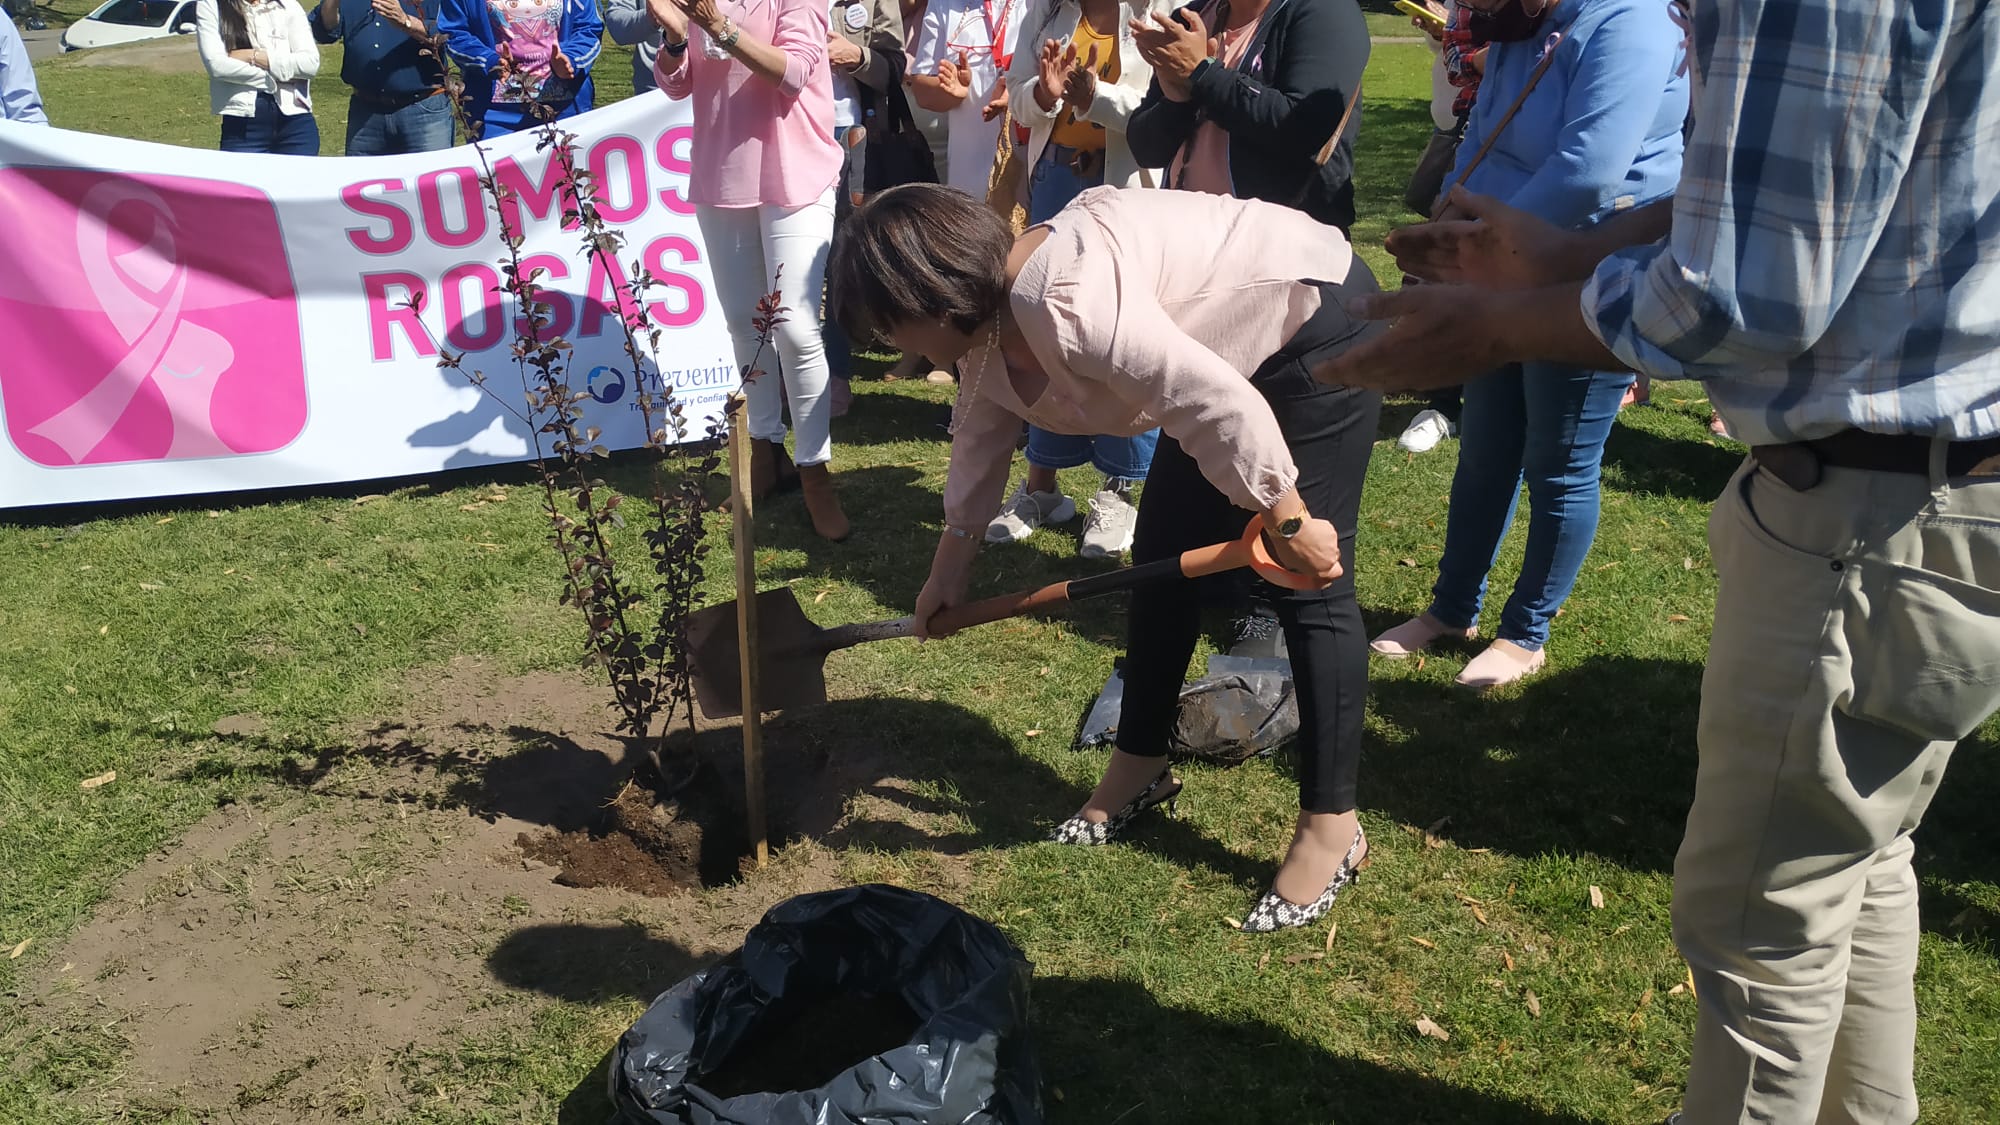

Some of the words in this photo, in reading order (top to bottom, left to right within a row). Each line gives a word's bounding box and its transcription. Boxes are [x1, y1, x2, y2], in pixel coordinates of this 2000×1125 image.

[340, 126, 697, 255] SOMOS
[360, 235, 706, 362] ROSAS
[632, 358, 733, 392] Prevenir
[689, 398, 695, 407] y
[697, 393, 730, 404] Confian
